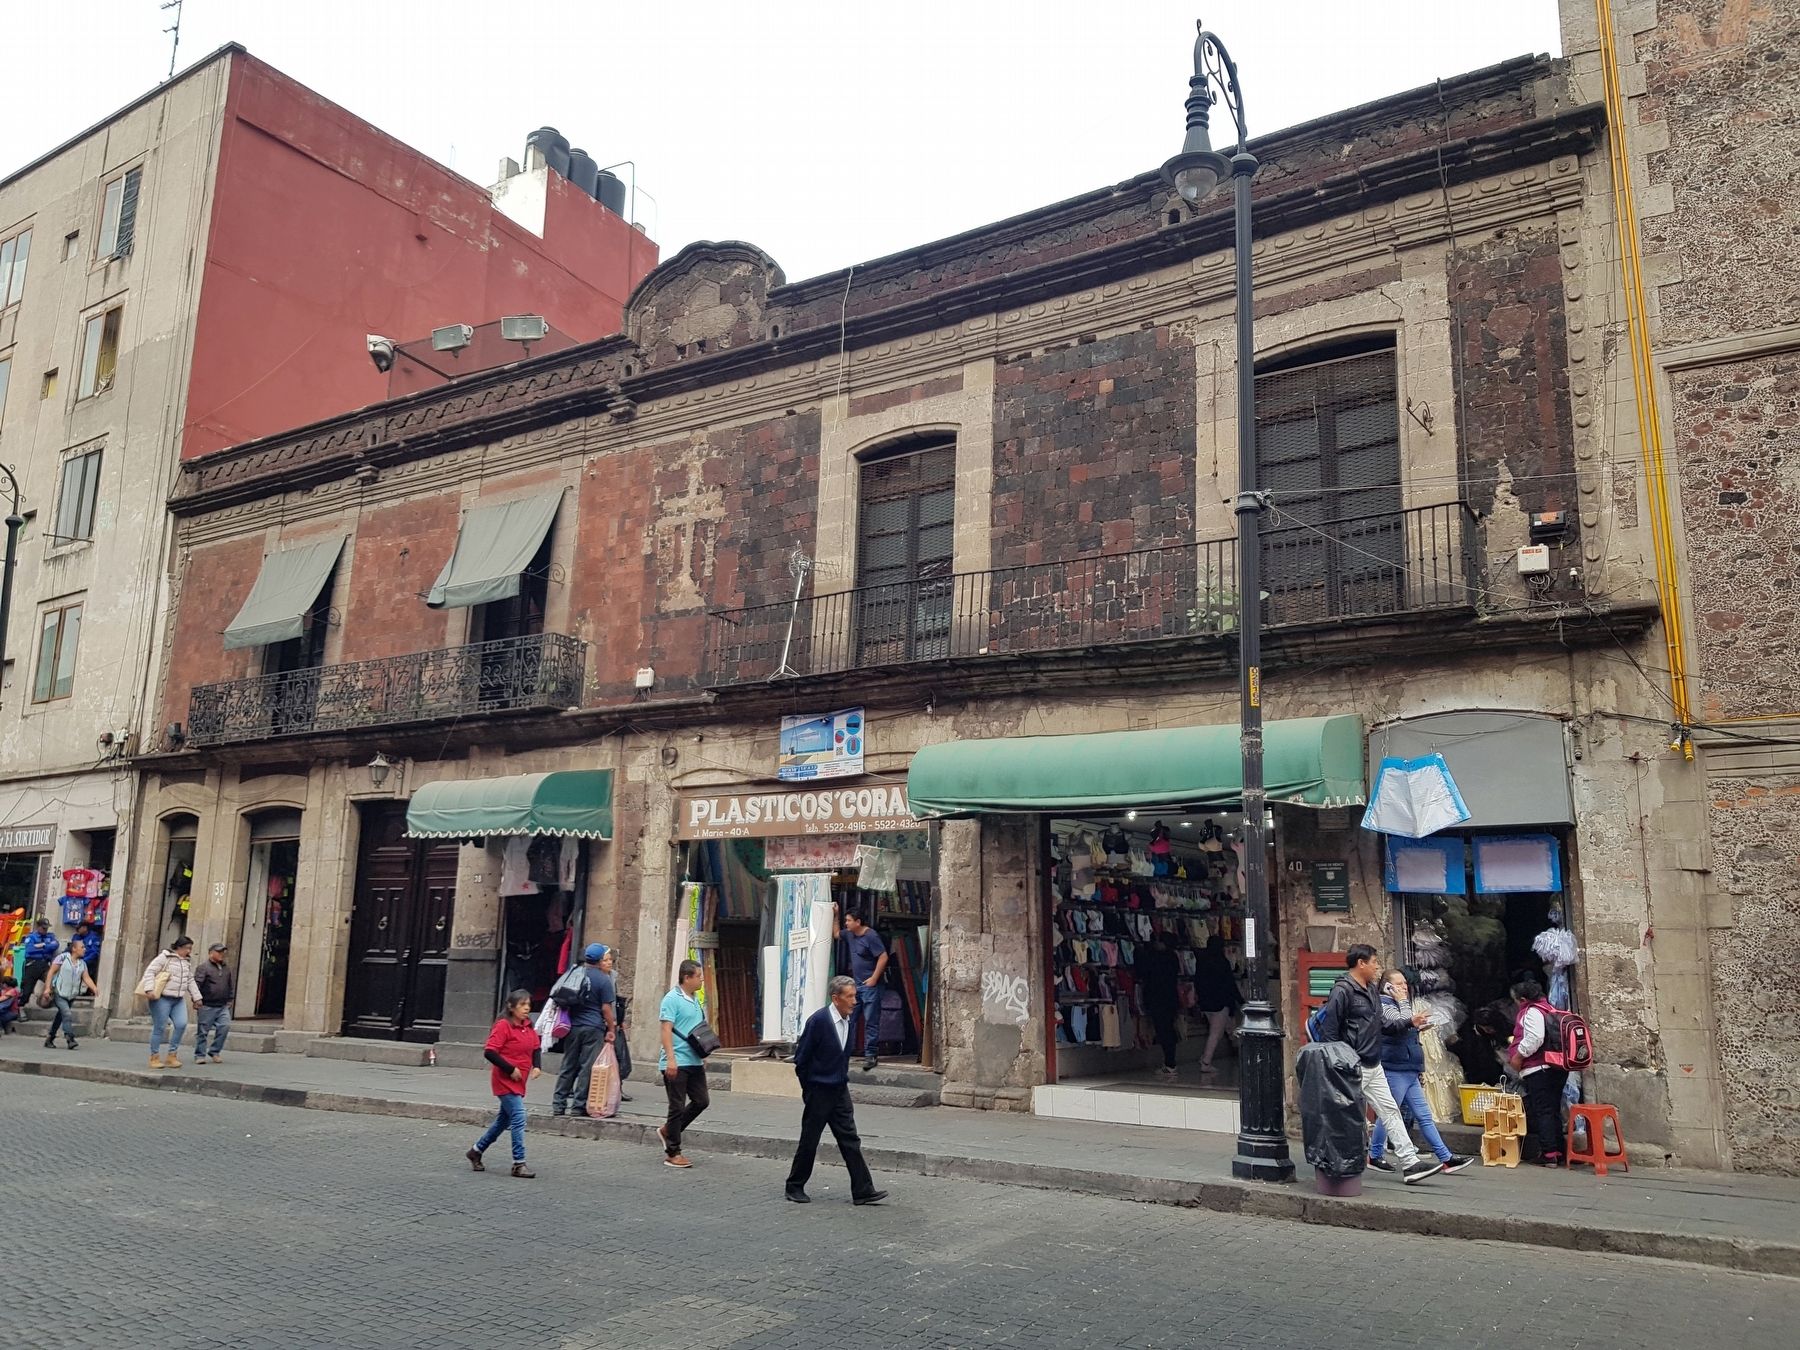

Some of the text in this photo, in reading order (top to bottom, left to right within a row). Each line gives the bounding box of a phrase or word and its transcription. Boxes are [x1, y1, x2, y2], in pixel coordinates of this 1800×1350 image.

[690, 791, 833, 827] PLASTICOS
[52, 865, 61, 879] 36
[1288, 861, 1302, 871] 40
[215, 882, 224, 896] 38
